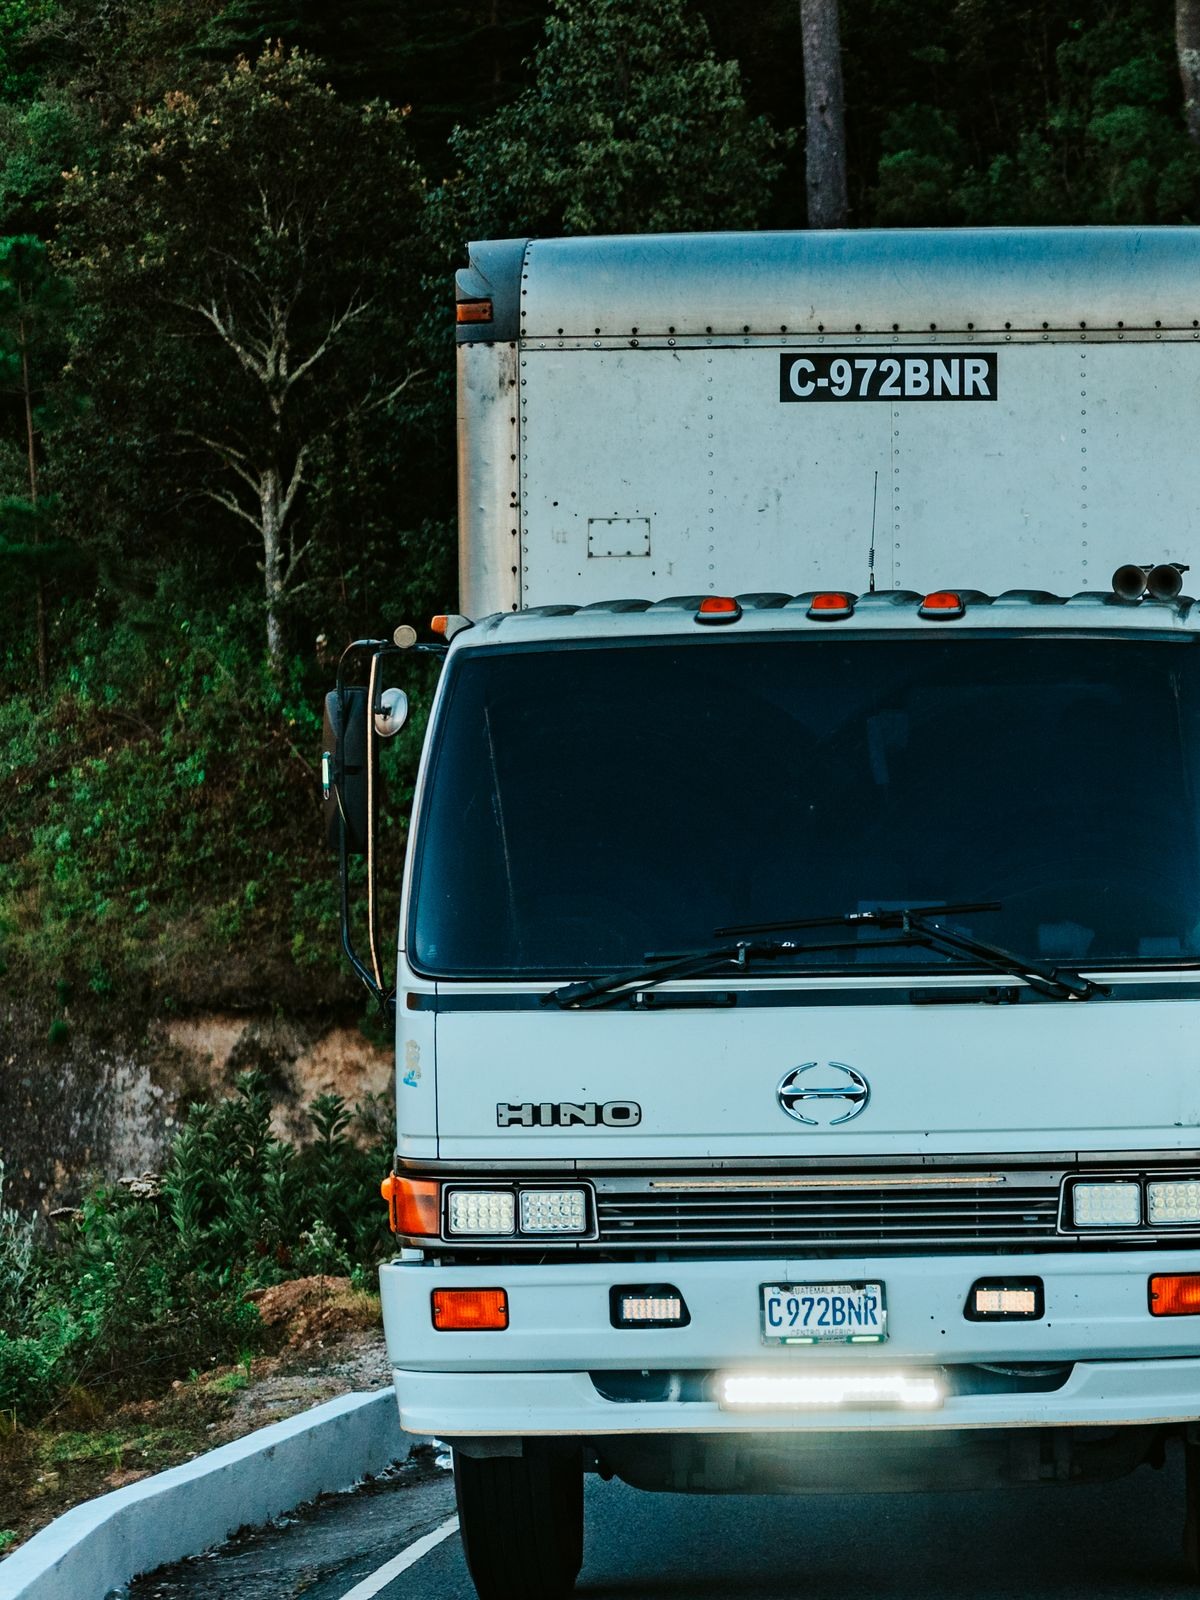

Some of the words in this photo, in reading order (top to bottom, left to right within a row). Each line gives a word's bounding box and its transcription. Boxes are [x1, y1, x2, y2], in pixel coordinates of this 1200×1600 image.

[789, 359, 991, 397] C-972BNR
[497, 1100, 641, 1127] HINO
[791, 1286, 836, 1295] UATEMALA
